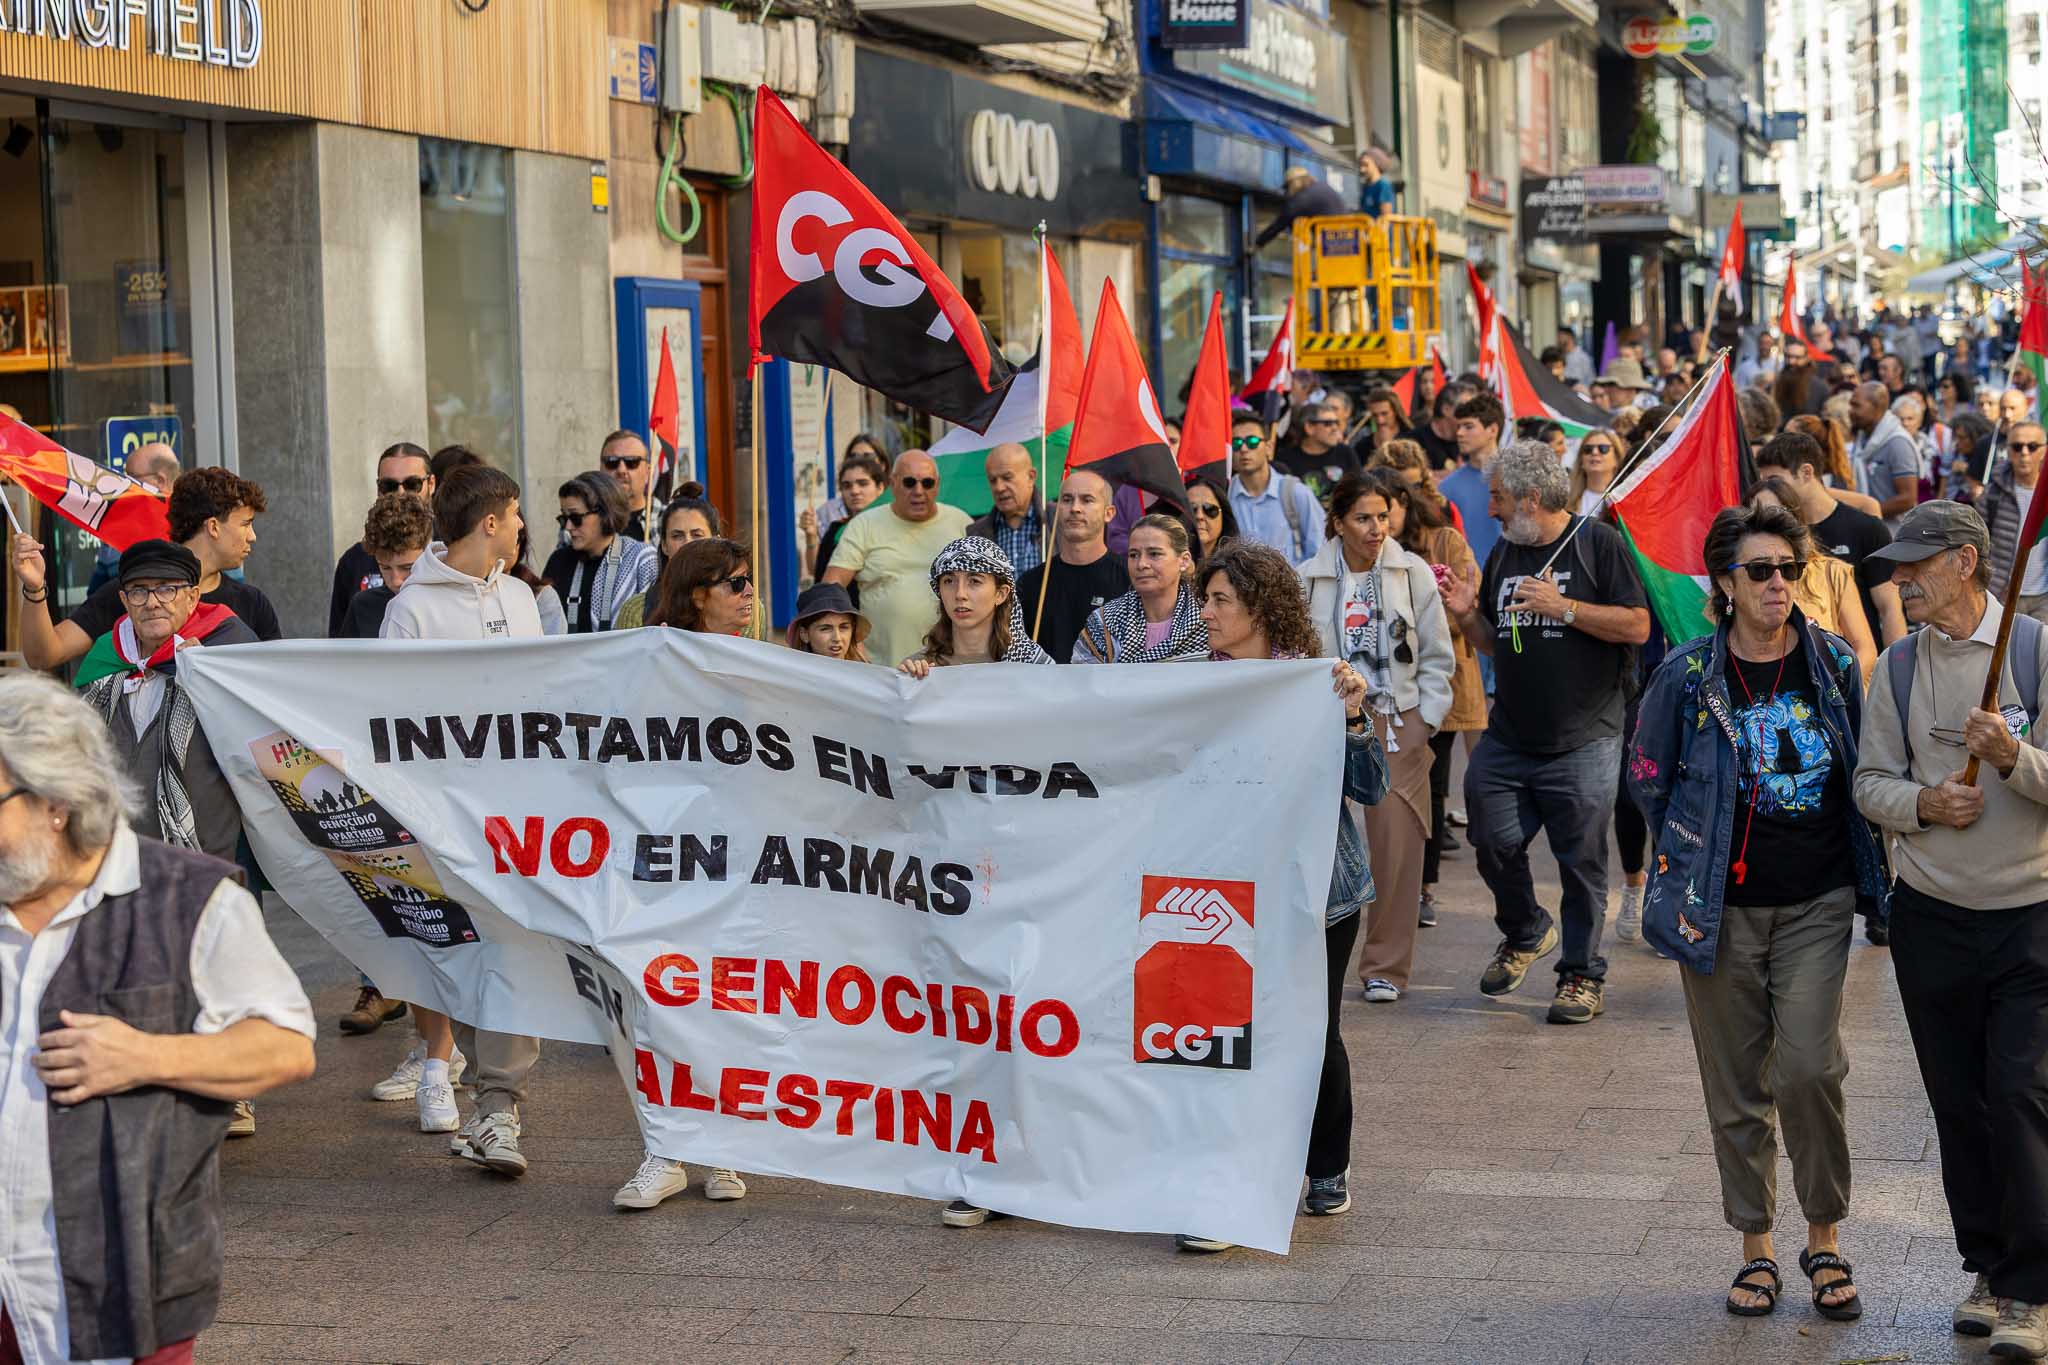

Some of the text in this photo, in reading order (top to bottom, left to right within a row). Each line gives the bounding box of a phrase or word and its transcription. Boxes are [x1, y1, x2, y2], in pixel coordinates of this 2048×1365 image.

[1170, 4, 1237, 22] House
[971, 108, 1060, 202] COCO
[369, 712, 795, 771] INVIRTAMOS
[812, 735, 894, 800] EN
[907, 761, 1100, 800] VIDA
[319, 812, 377, 830] GENOCIDIO
[327, 827, 384, 841] APARTHEID
[484, 815, 974, 916] NO EN ARMAS
[643, 953, 1081, 1058] GENOCIDIO
[1141, 1022, 1245, 1065] CGT
